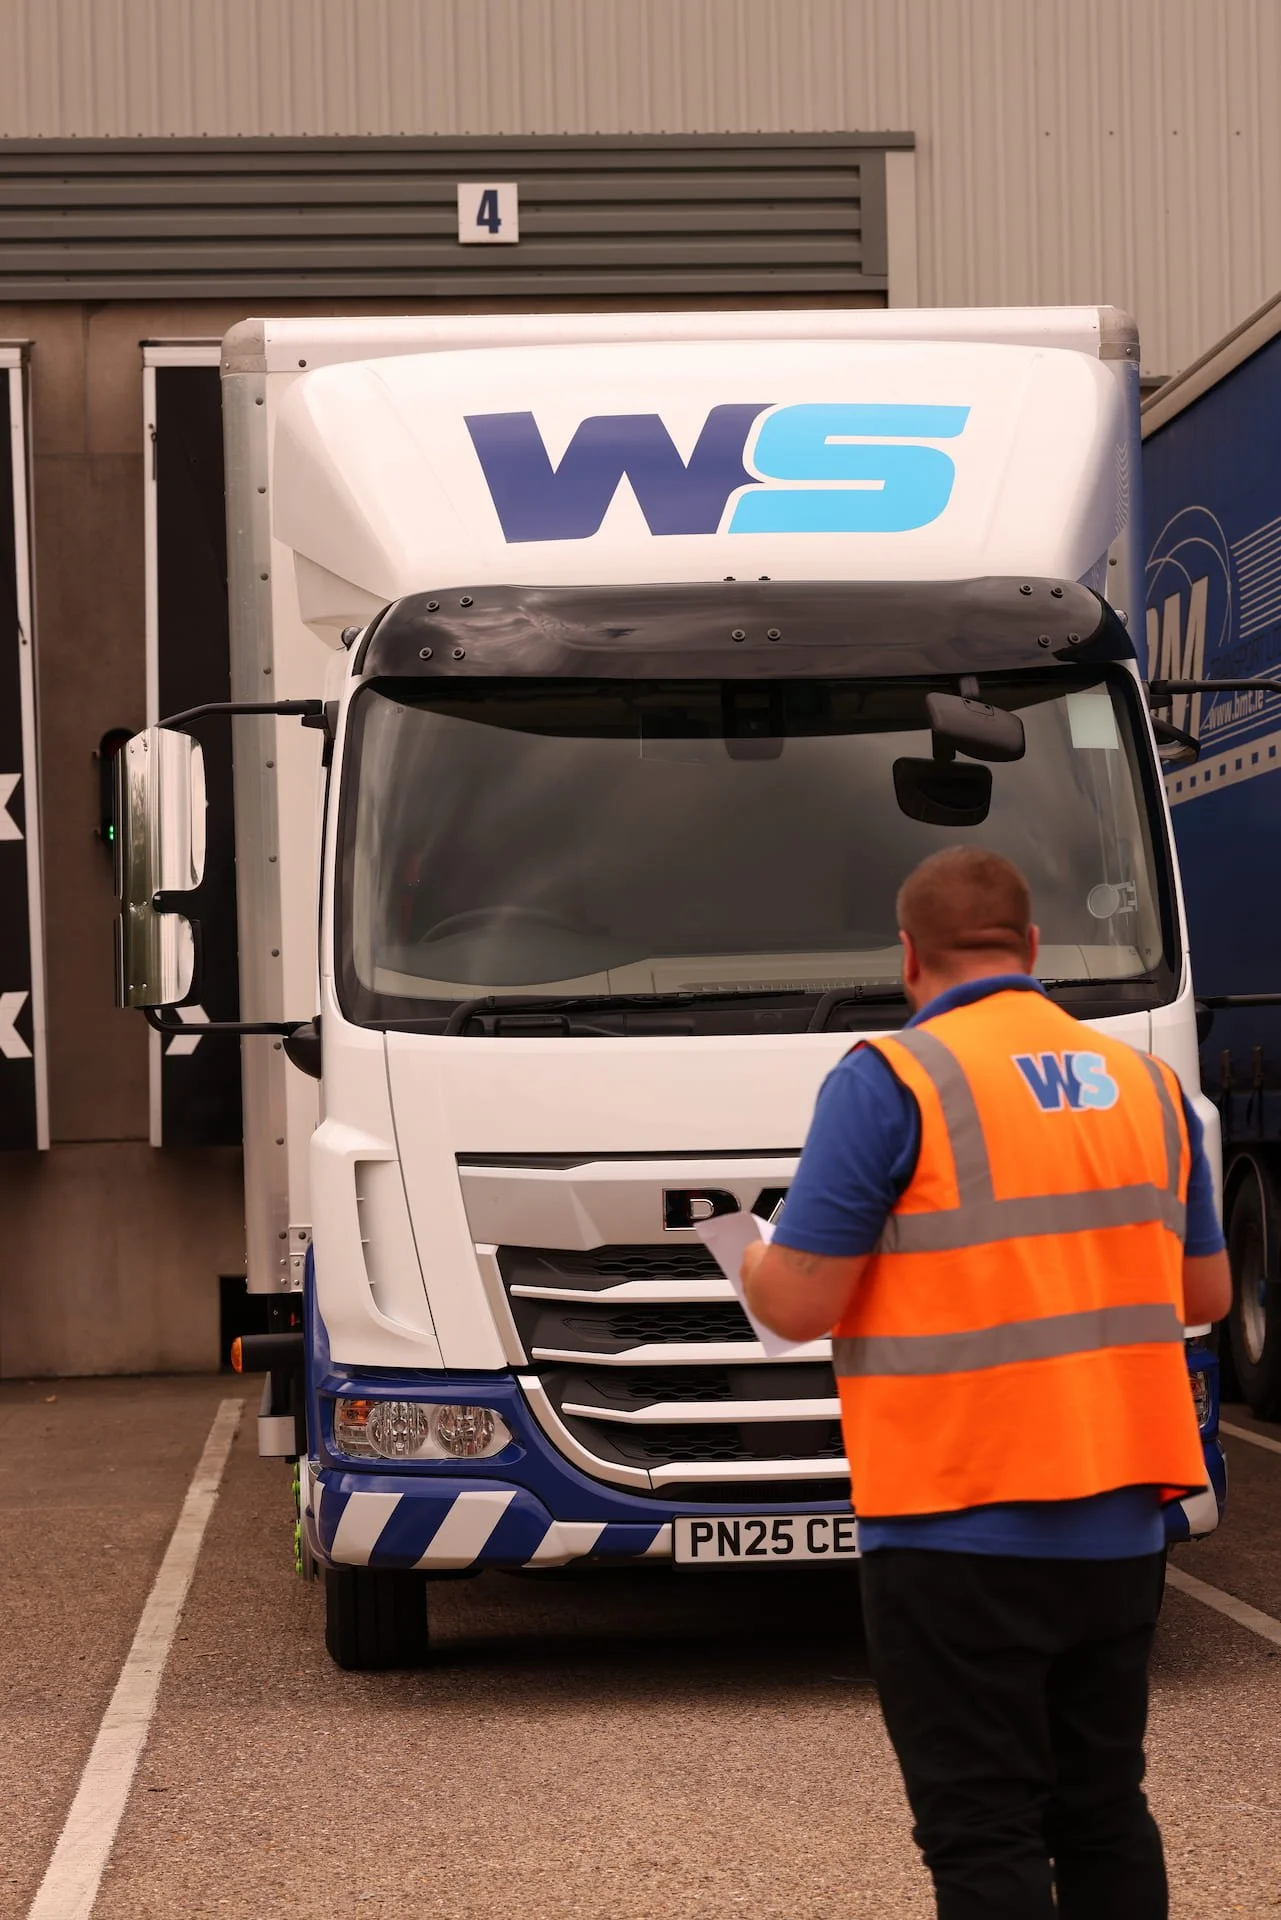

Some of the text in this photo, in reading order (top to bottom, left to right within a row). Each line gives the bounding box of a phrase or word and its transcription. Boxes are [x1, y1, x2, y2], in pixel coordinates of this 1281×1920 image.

[476, 189, 502, 234] 4
[463, 402, 972, 544] WS
[1012, 1051, 1120, 1112] WS
[691, 1520, 793, 1557] PN25
